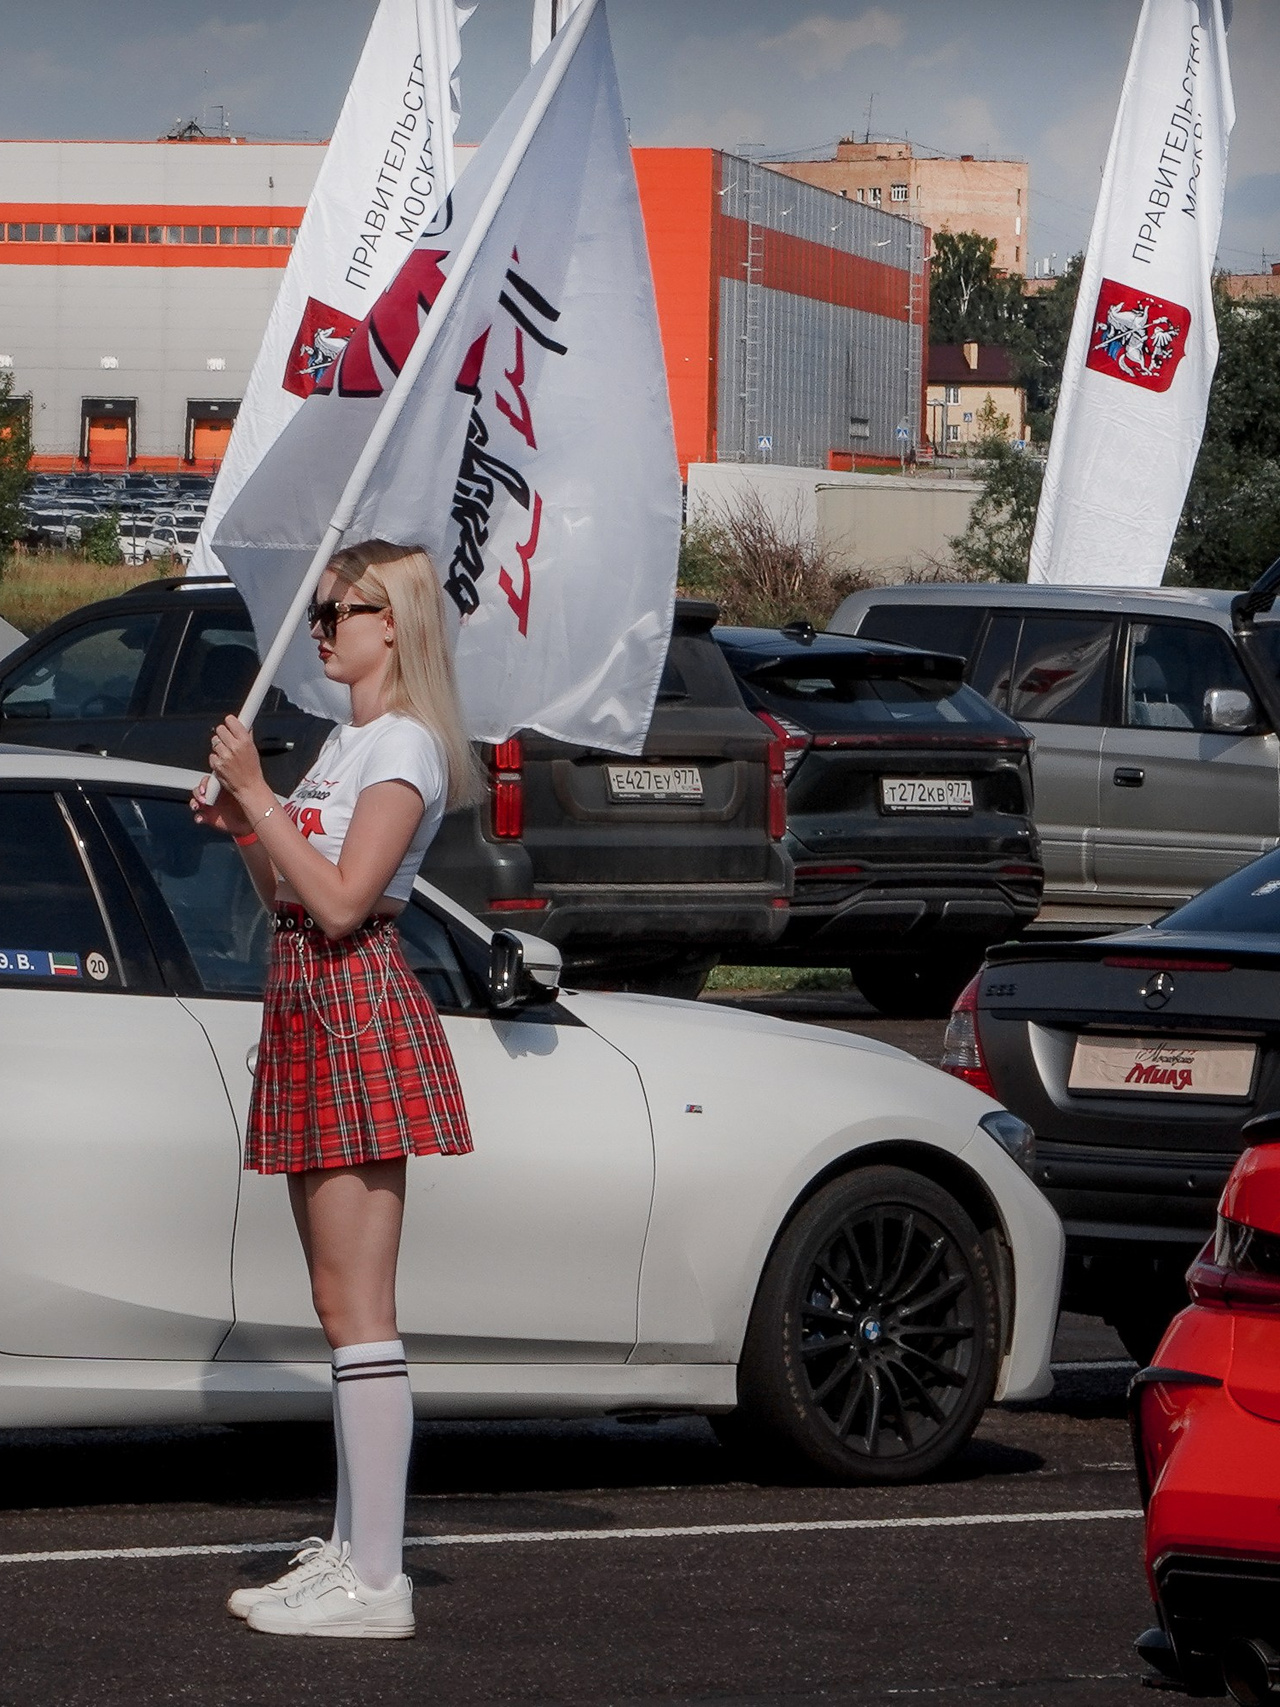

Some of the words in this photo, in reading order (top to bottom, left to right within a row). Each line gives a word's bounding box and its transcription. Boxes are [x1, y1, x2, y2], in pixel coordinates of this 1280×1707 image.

[674, 770, 695, 784] 977
[947, 783, 968, 797] 977
[17, 953, 35, 970] В.
[90, 959, 106, 974] 20
